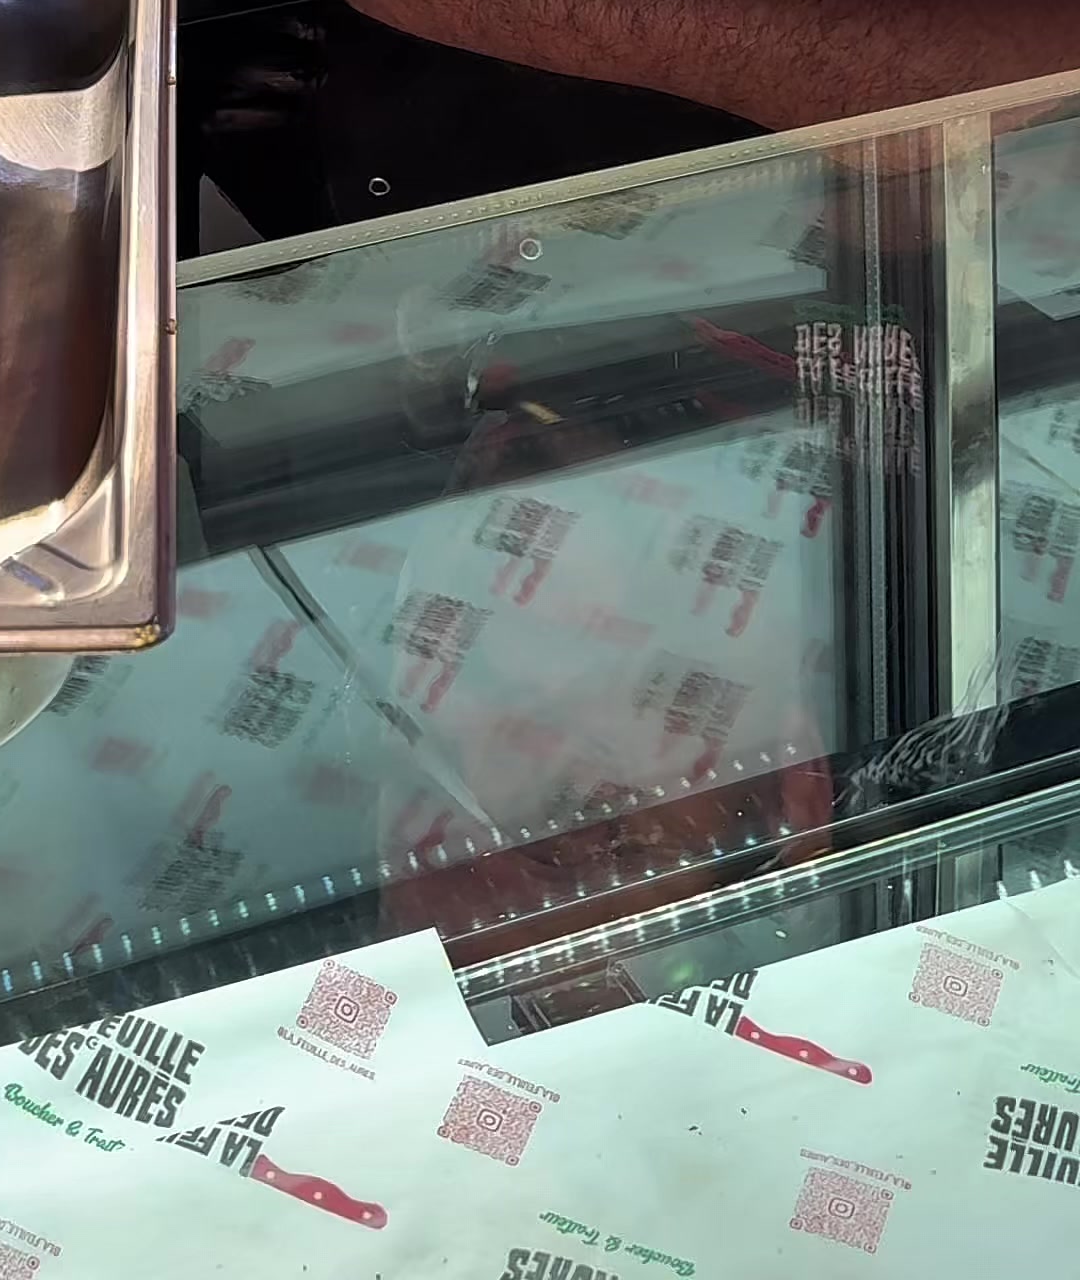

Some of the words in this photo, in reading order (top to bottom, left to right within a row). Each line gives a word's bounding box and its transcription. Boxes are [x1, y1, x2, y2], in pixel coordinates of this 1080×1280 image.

[703, 993, 744, 1037] LA
[83, 1013, 206, 1085] EUILLE
[3, 1081, 65, 1128] Boucher
[65, 1120, 85, 1138] &
[219, 1130, 264, 1178] LA
[538, 1210, 601, 1246] Traiteur
[604, 1234, 623, 1253] &
[624, 1243, 697, 1277] Boucher
